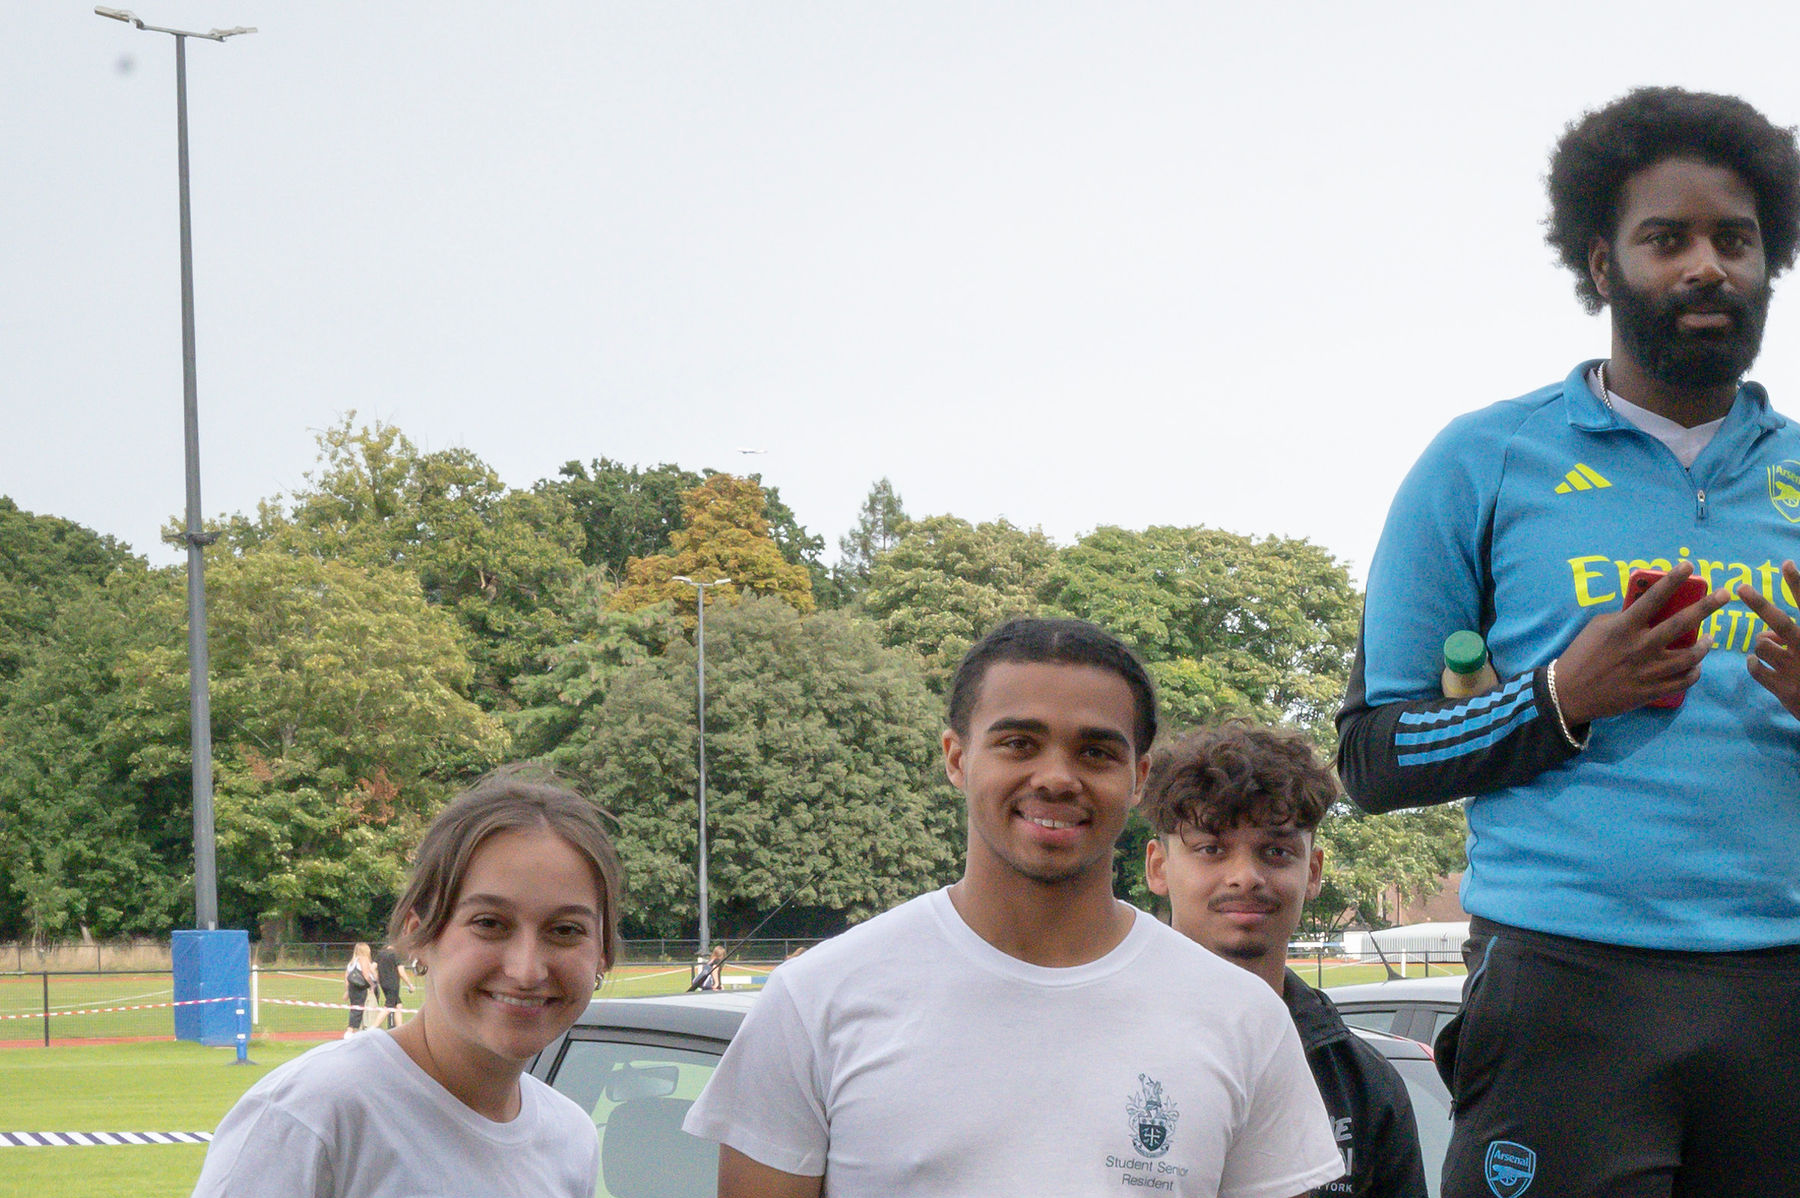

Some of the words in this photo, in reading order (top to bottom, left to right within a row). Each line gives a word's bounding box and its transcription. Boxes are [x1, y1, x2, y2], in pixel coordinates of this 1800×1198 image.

[1105, 1155, 1153, 1172] Student
[1493, 1149, 1529, 1167] Arsenal
[1121, 1173, 1174, 1191] Resident
